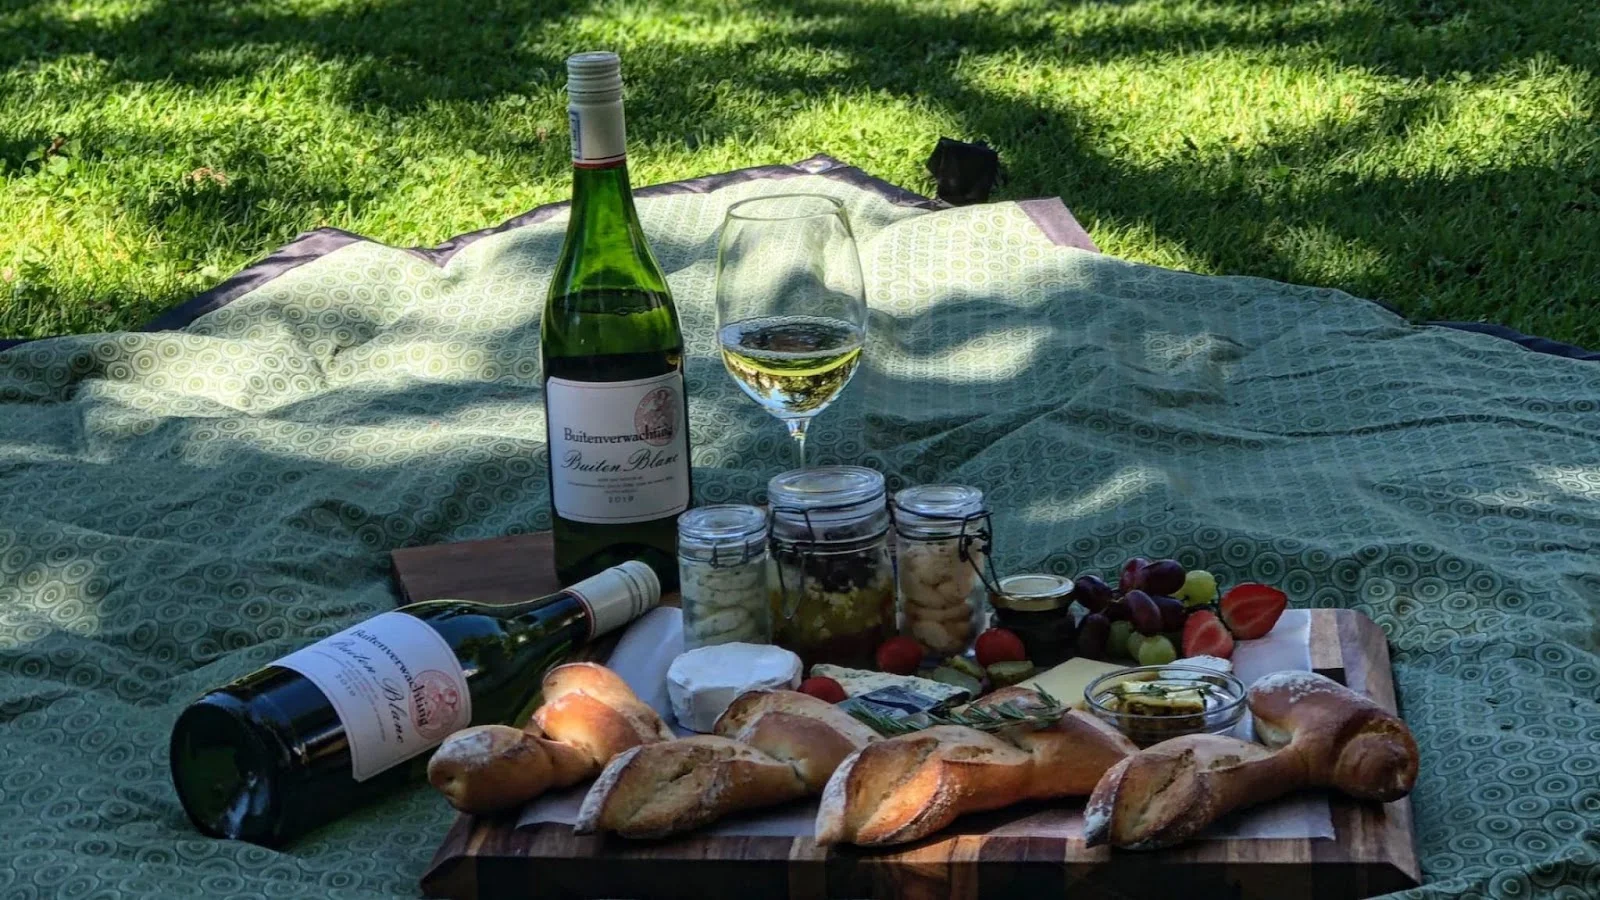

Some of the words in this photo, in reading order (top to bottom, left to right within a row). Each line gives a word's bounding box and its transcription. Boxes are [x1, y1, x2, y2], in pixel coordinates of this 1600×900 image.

[564, 425, 673, 444] Buitenverwachting
[561, 450, 621, 471] Buiten
[624, 448, 679, 471] Blanc
[608, 496, 634, 504] 2019
[349, 629, 429, 727] Buitenverwachting
[329, 639, 376, 674] Buiten
[373, 677, 408, 744] Blanc
